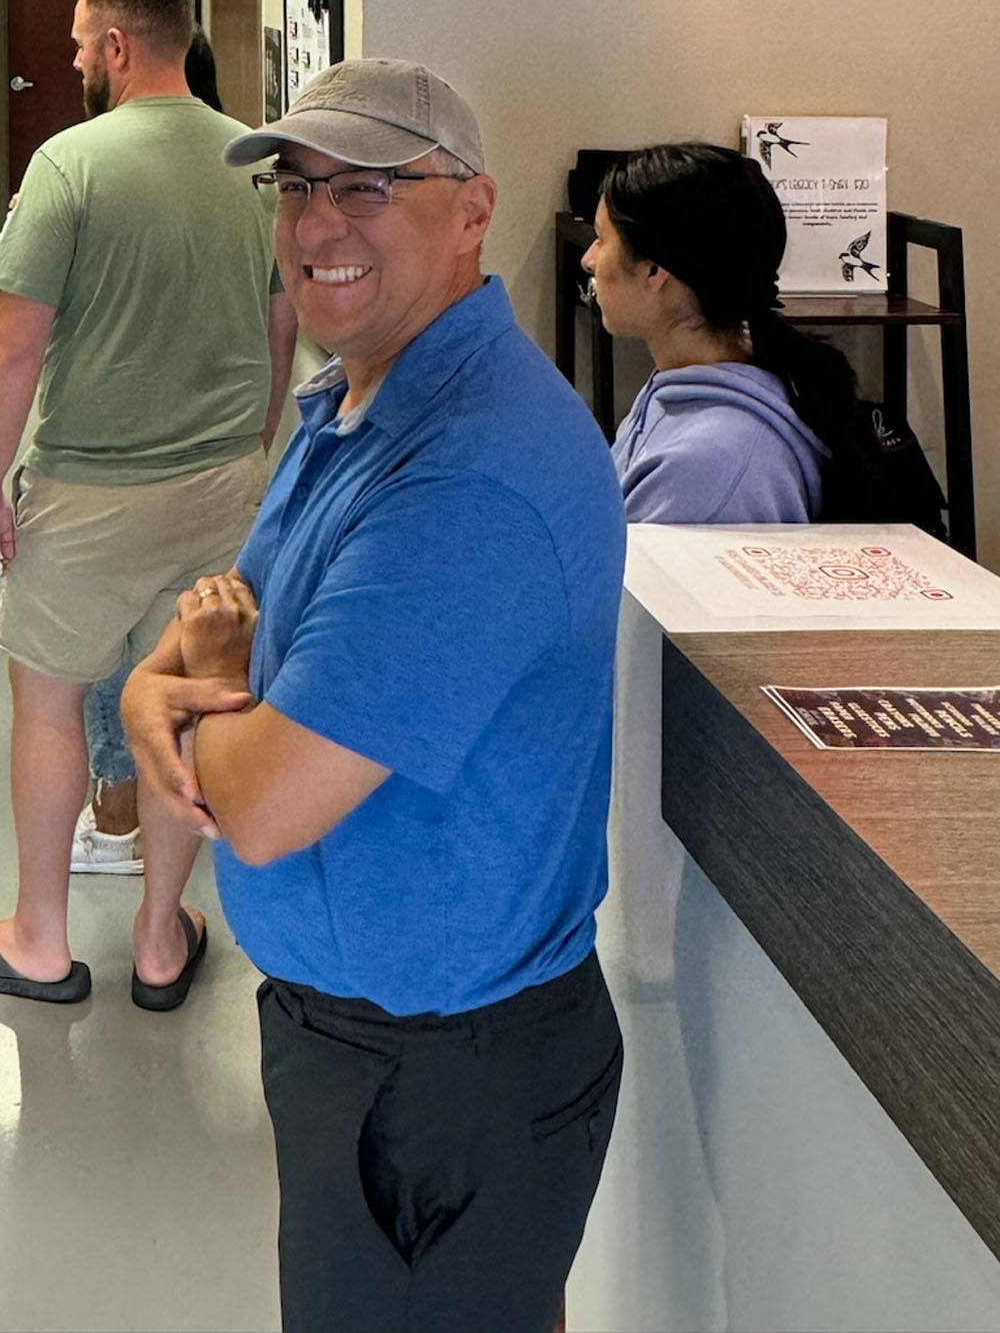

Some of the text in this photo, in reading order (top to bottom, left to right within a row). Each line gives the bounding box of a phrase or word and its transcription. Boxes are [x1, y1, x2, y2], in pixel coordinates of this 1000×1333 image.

[816, 707, 858, 739] ERASERS
[873, 712, 902, 731] PENS
[877, 699, 915, 728] CRAYONS
[933, 710, 974, 739] PENCILS
